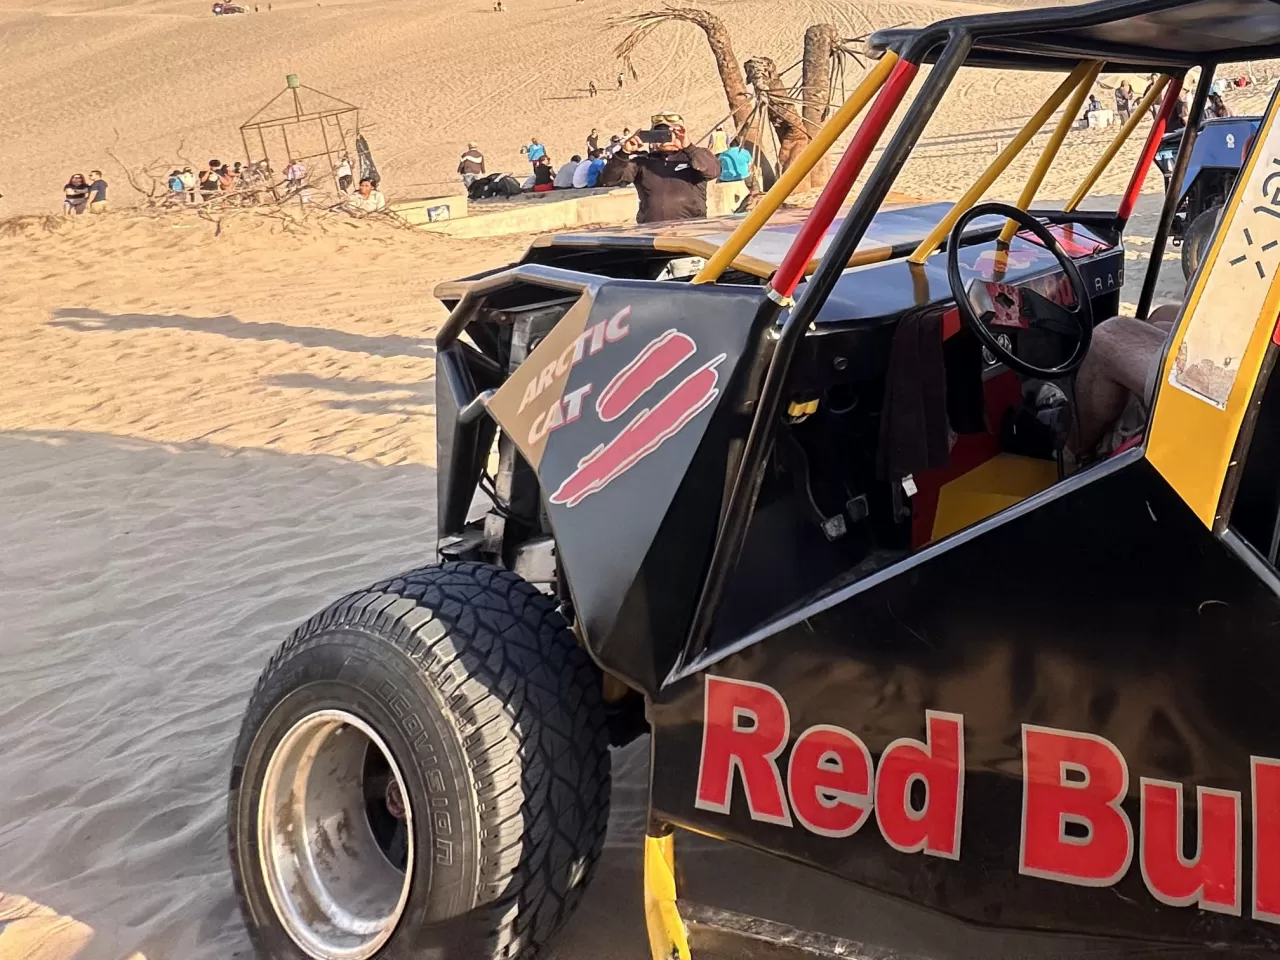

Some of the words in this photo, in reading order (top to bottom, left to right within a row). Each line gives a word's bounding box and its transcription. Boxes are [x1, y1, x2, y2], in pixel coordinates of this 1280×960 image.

[517, 304, 632, 416] ARCTIC
[528, 383, 592, 445] CAT
[695, 674, 965, 860] Red
